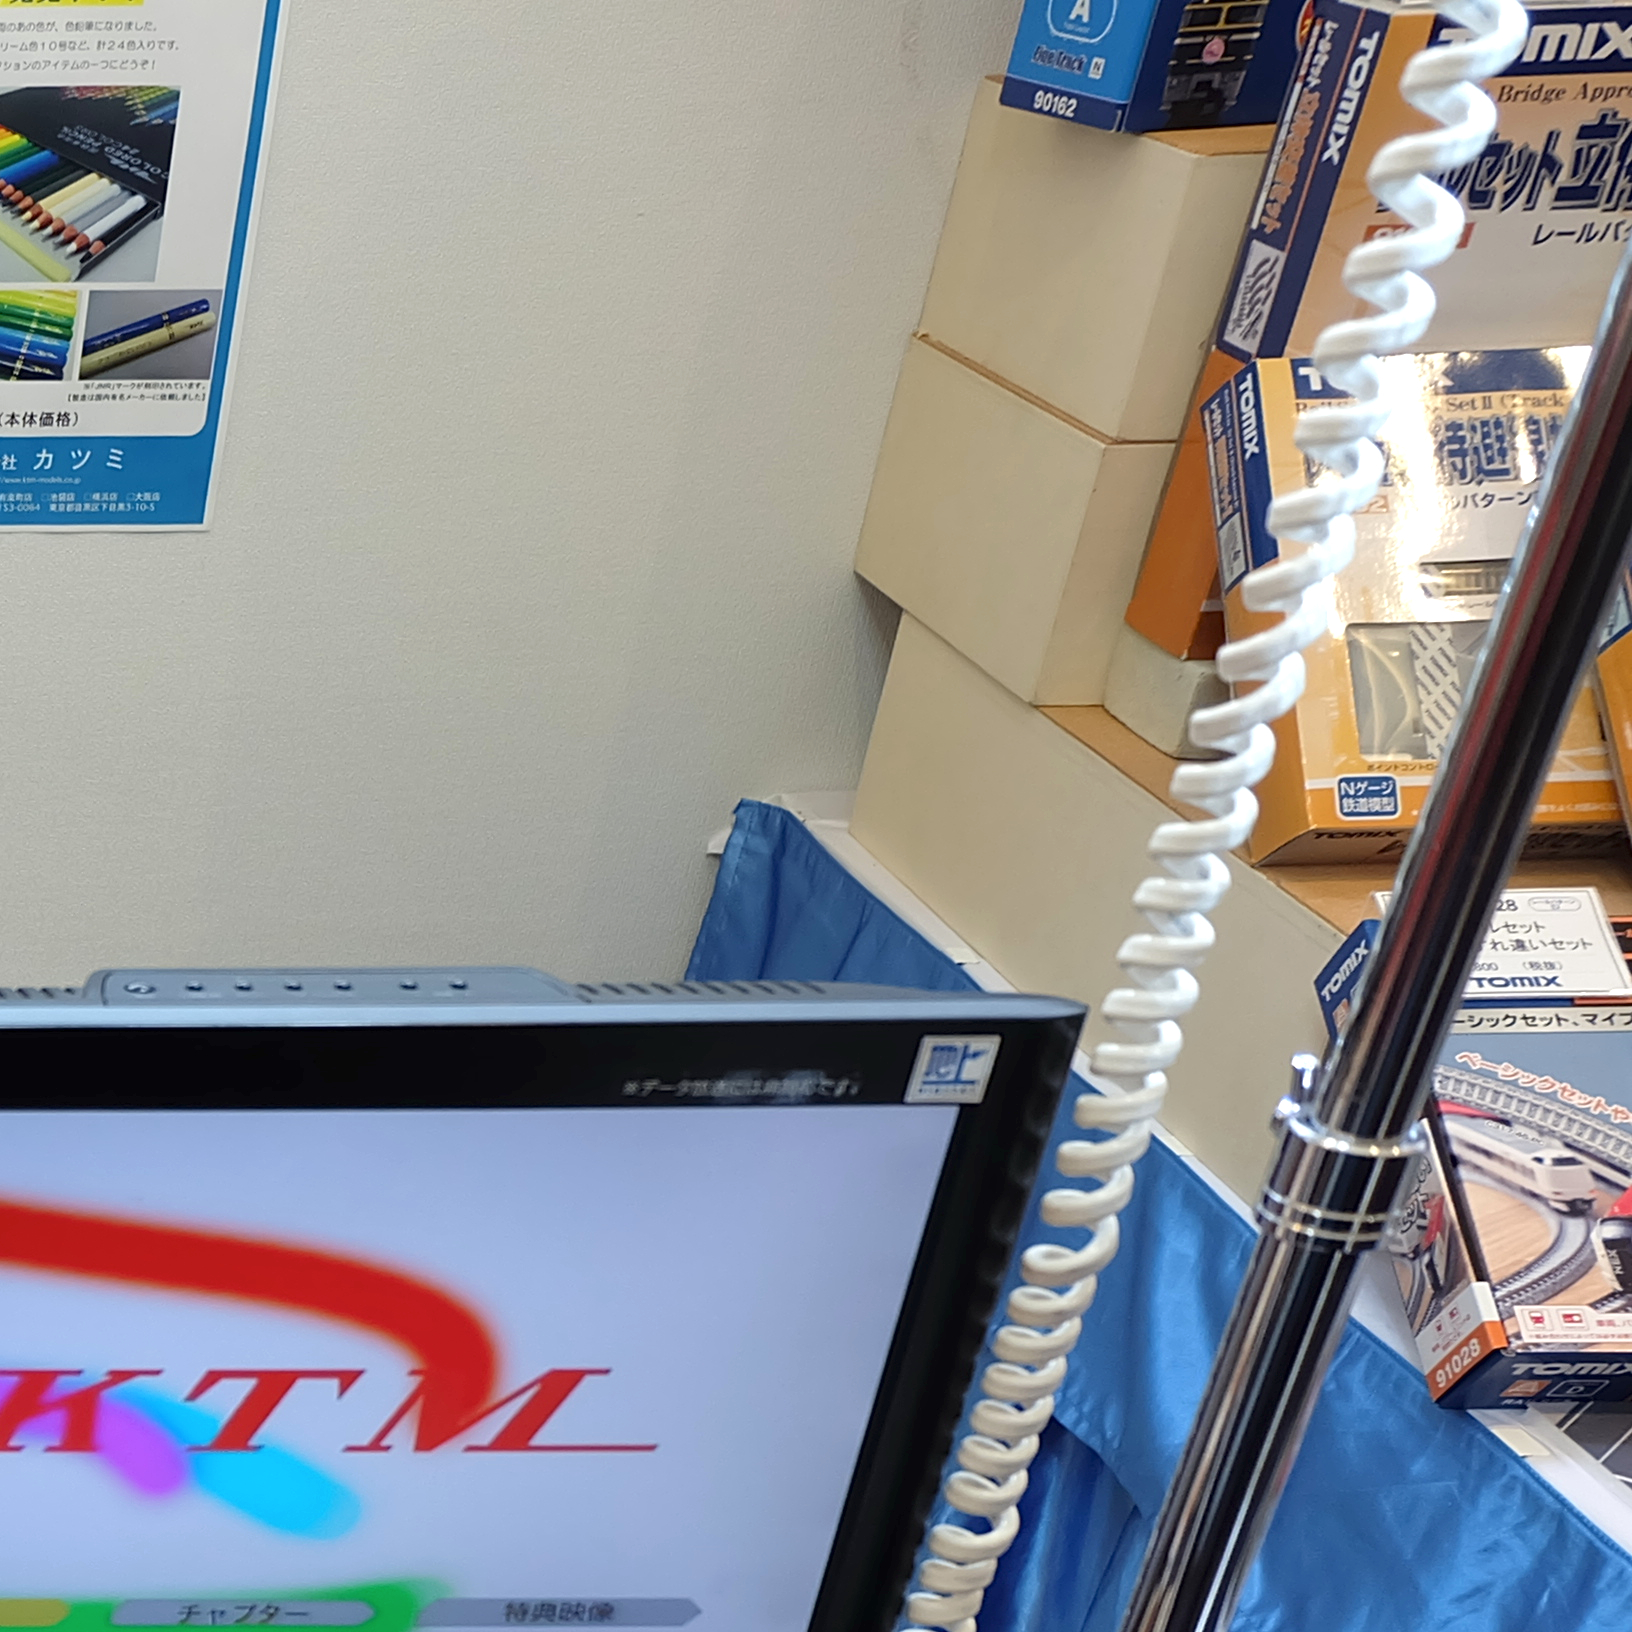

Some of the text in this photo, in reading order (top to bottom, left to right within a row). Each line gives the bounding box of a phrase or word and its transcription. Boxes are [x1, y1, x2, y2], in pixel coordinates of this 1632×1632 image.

[1069, 0, 1090, 23] A
[1033, 90, 1077, 118] 90162
[1321, 31, 1380, 165] TOMIX
[1497, 82, 1567, 104] Bridge
[1236, 373, 1261, 461] TOMIX
[1446, 399, 1476, 413] Set
[33, 448, 126, 470] カツミ
[1340, 780, 1395, 797] Nゲージ
[1341, 796, 1396, 814] 鉄道模型
[1321, 940, 1369, 1002] TOMIX
[1470, 976, 1564, 988] TOMIX
[1434, 1337, 1482, 1390] 91028
[173, 1598, 311, 1627] チャプター
